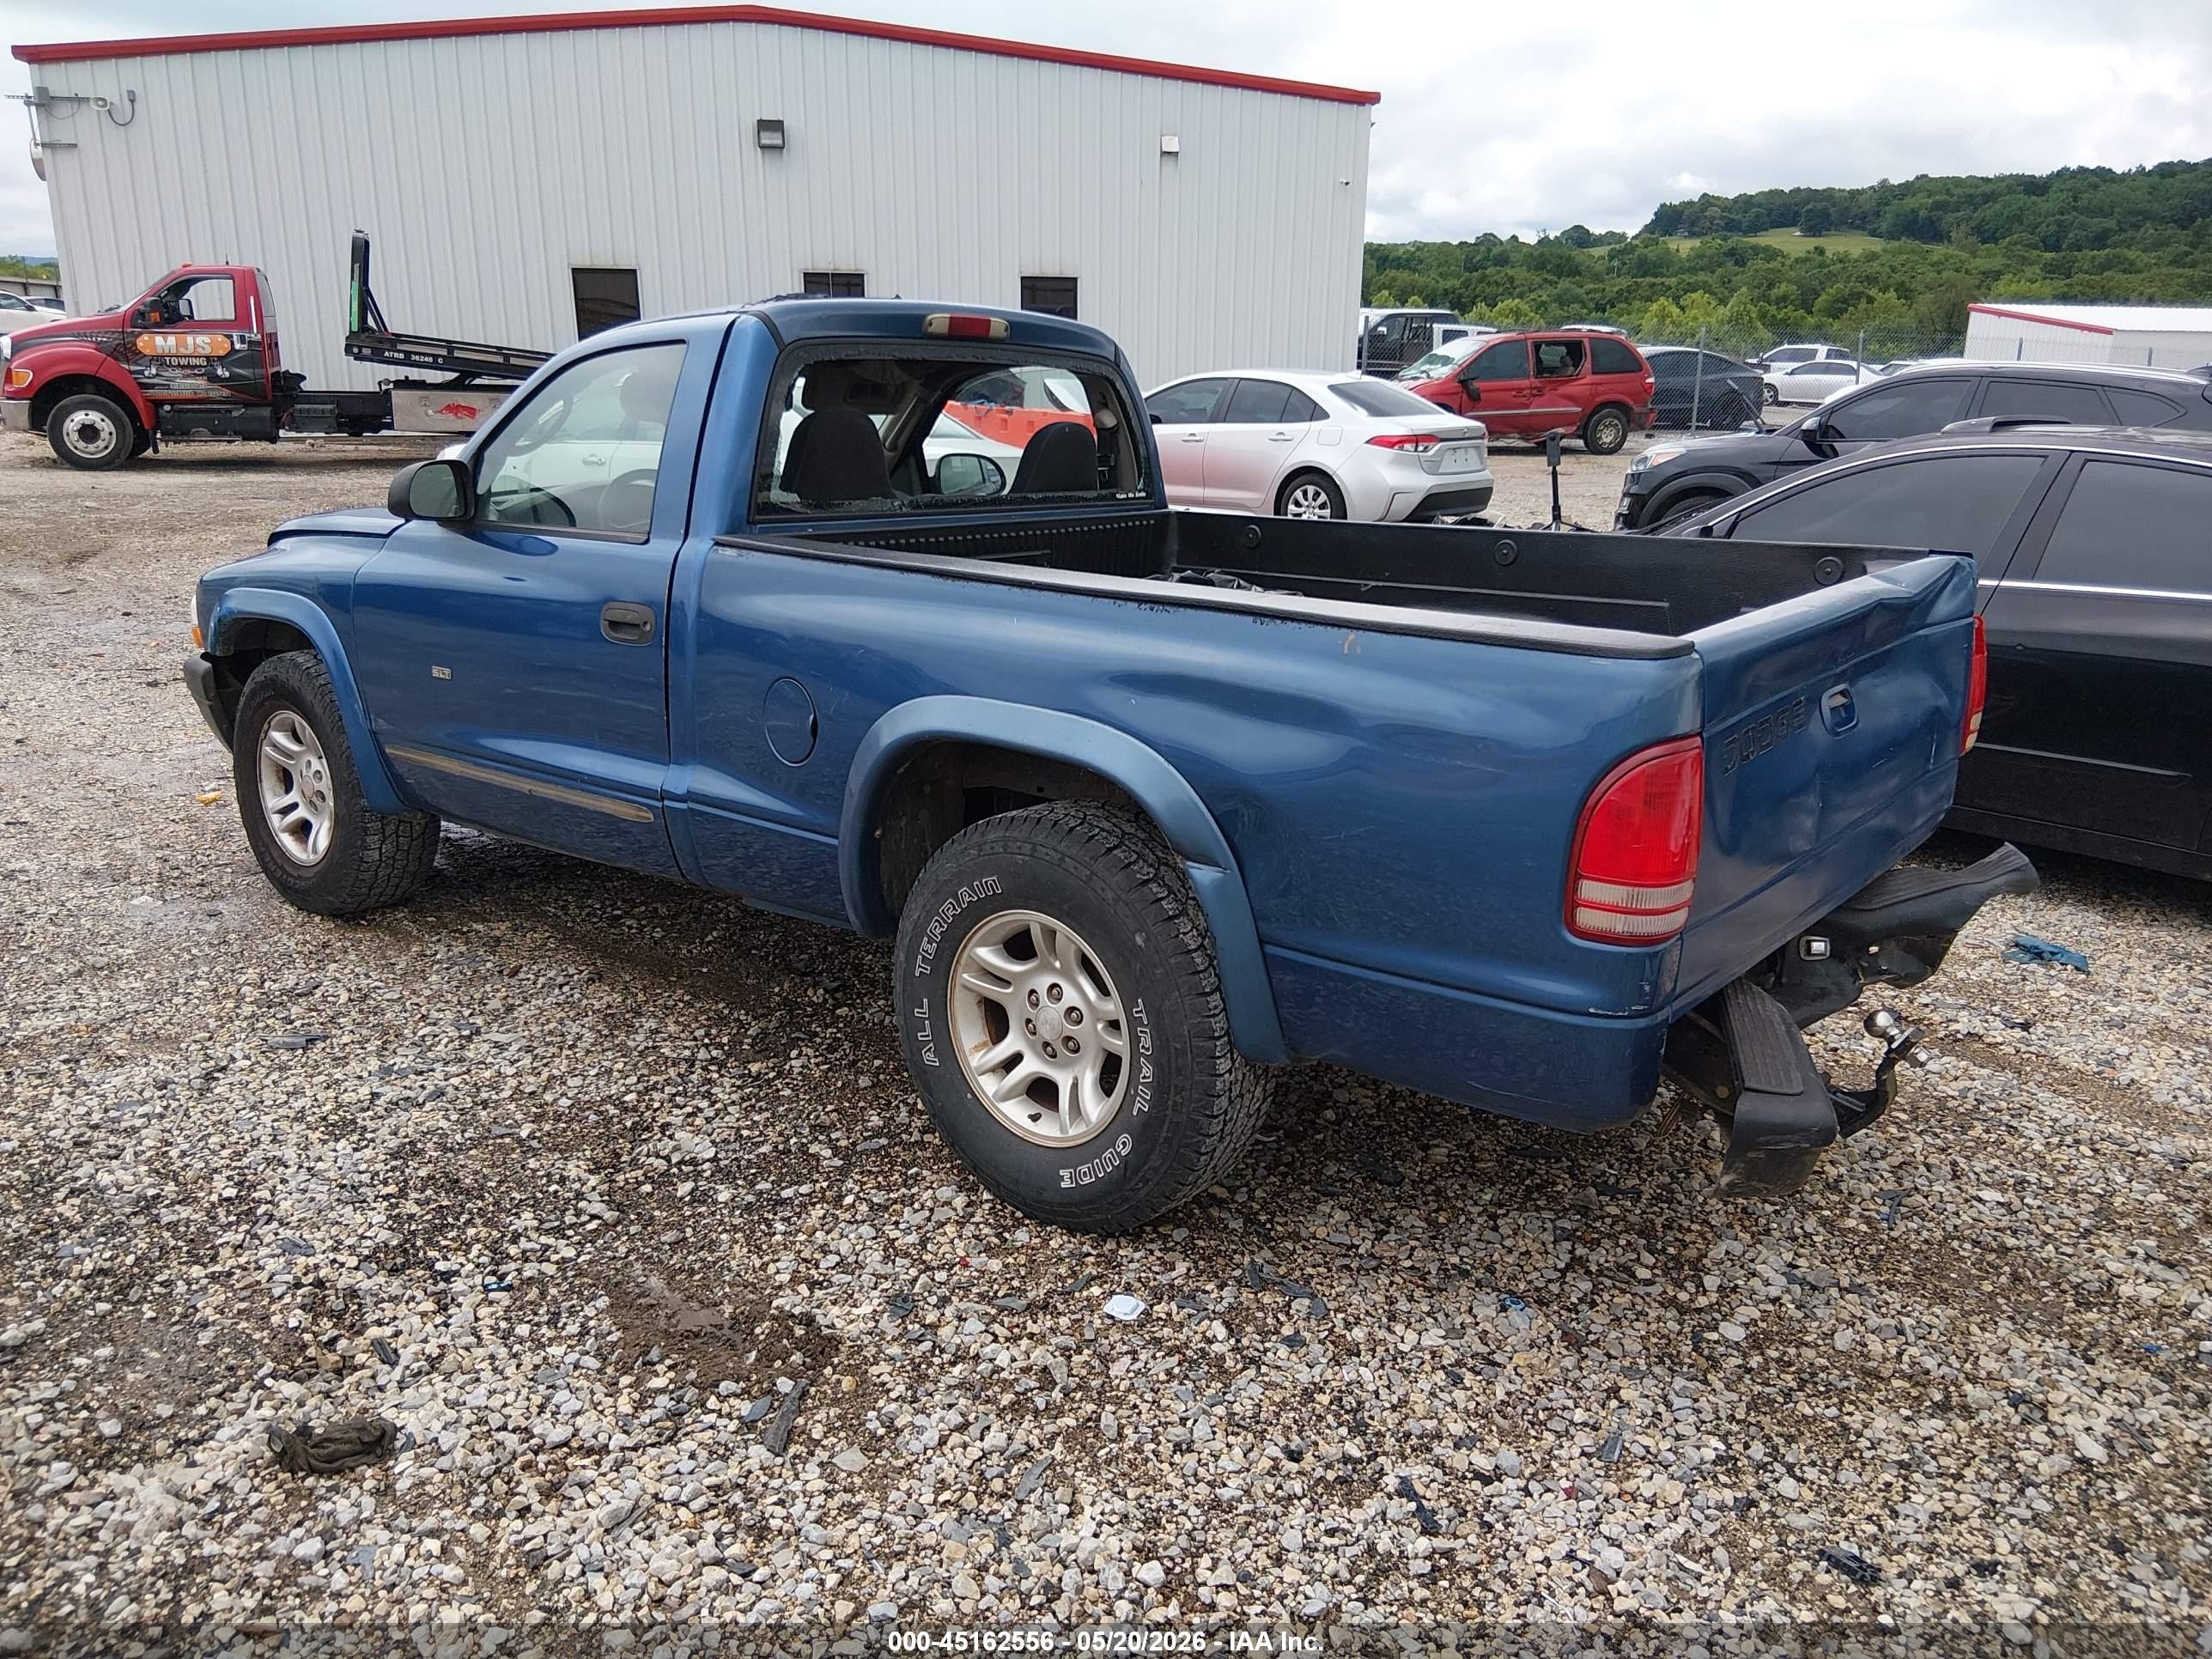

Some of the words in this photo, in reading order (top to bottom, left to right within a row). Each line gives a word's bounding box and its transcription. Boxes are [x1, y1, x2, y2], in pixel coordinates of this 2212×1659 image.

[155, 336, 213, 354] MJS
[164, 356, 208, 366] TOWING
[384, 350, 405, 360] ATRB
[432, 666, 451, 679] SLT
[915, 876, 1003, 979] TERRAIN
[915, 998, 941, 1066] ALL
[1131, 999, 1154, 1116] TRAIL
[1060, 1133, 1133, 1188] GUIDE
